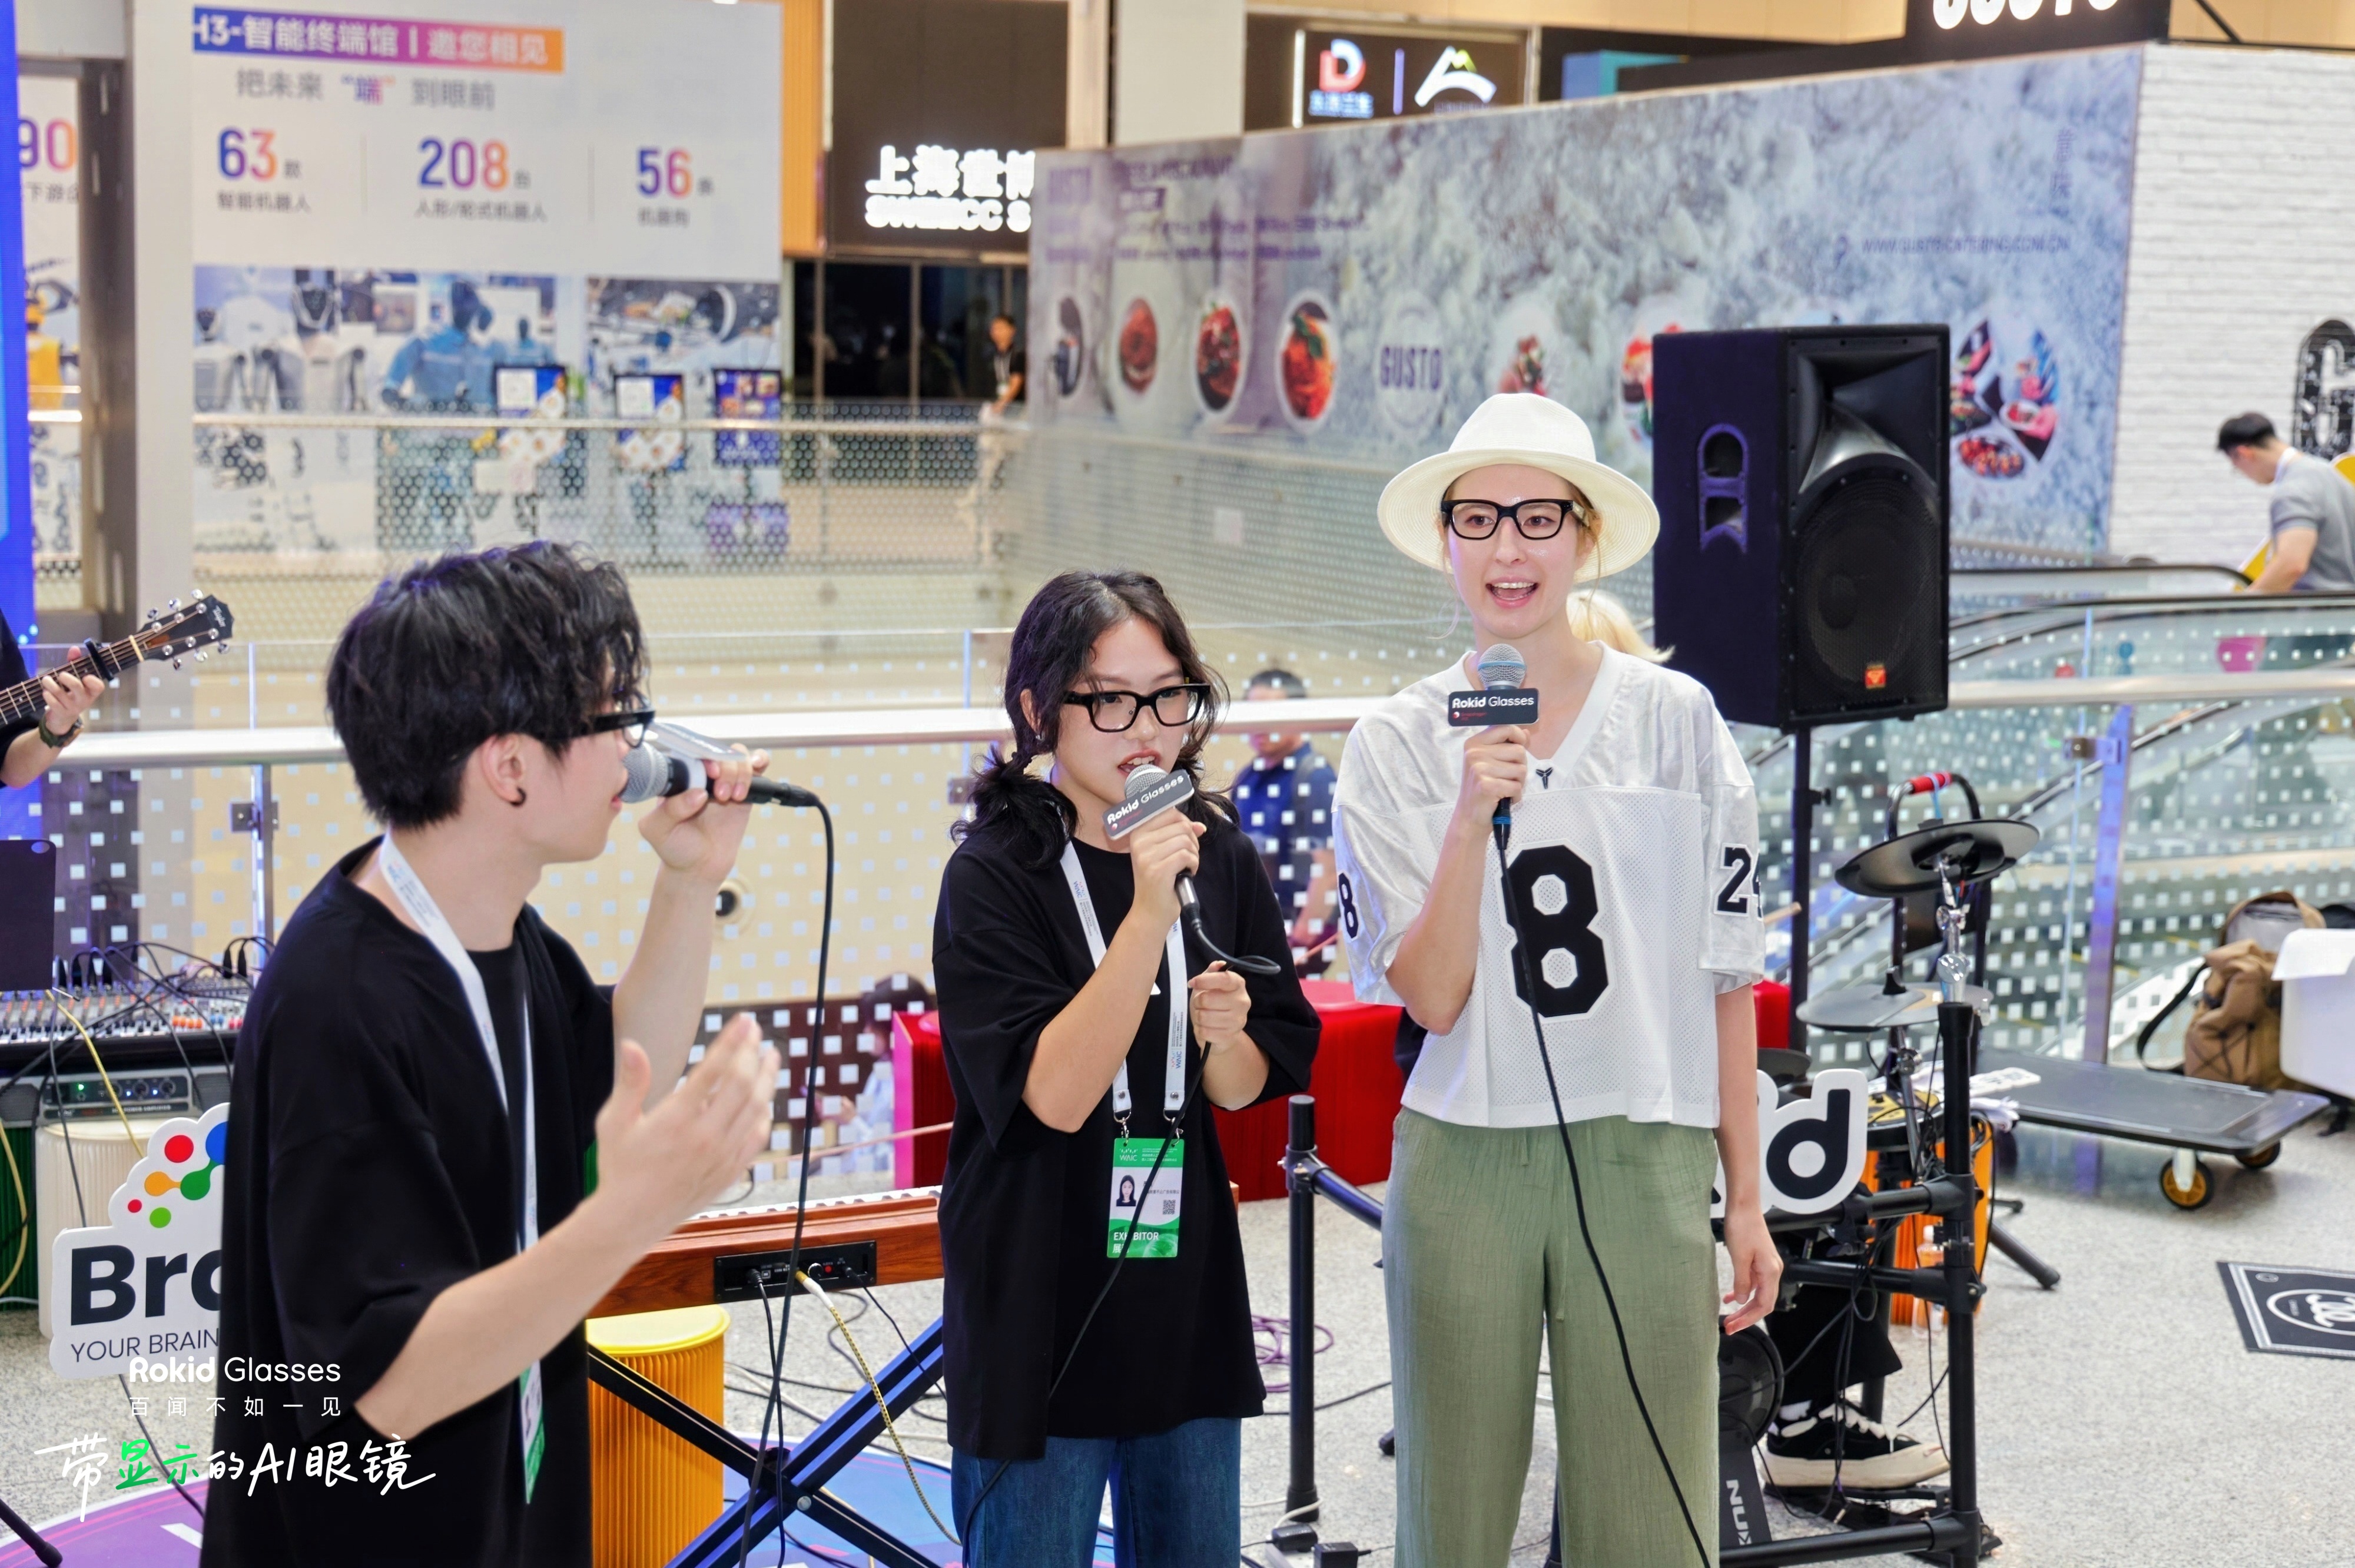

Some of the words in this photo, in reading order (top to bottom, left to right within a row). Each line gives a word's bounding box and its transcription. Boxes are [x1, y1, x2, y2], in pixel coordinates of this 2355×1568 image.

[218, 128, 277, 182] 63
[419, 138, 510, 191] 208
[637, 148, 692, 198] 56
[1381, 346, 1440, 389] GUSTO
[1452, 697, 1486, 708] Rokid
[1488, 696, 1534, 707] Glasses
[1107, 799, 1139, 824] Rokid
[1140, 775, 1184, 804] Glasses
[1501, 843, 1611, 1019] 8
[1113, 1232, 1159, 1241] EXHBITOR
[71, 1337, 141, 1363] YOUR
[149, 1328, 220, 1354] BRAIN
